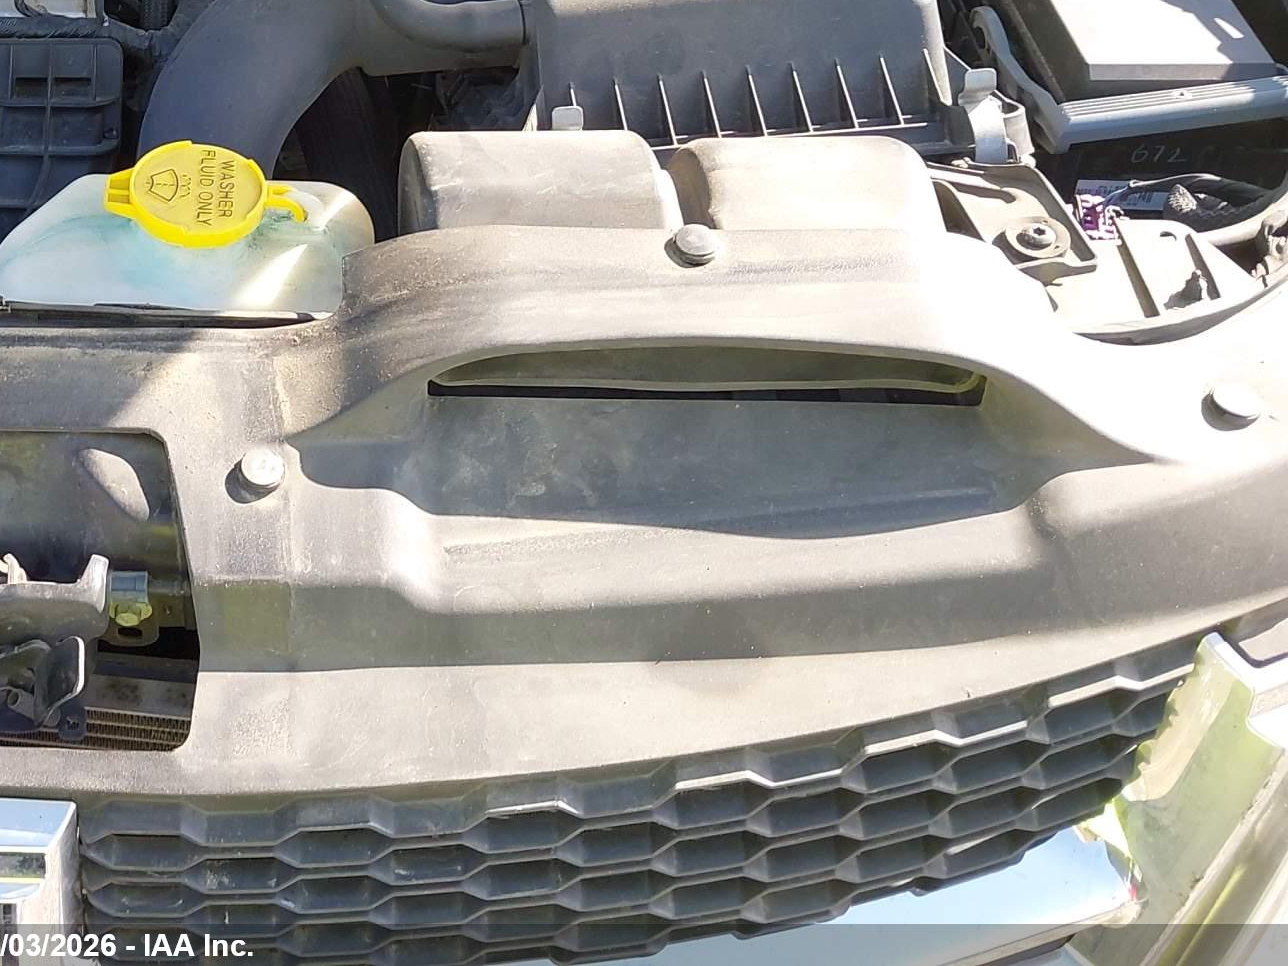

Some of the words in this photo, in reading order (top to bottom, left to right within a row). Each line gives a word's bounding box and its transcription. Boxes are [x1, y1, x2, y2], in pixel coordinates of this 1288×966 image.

[198, 149, 217, 188] FLUID
[218, 160, 236, 218] WASHER
[196, 191, 215, 227] ONLY
